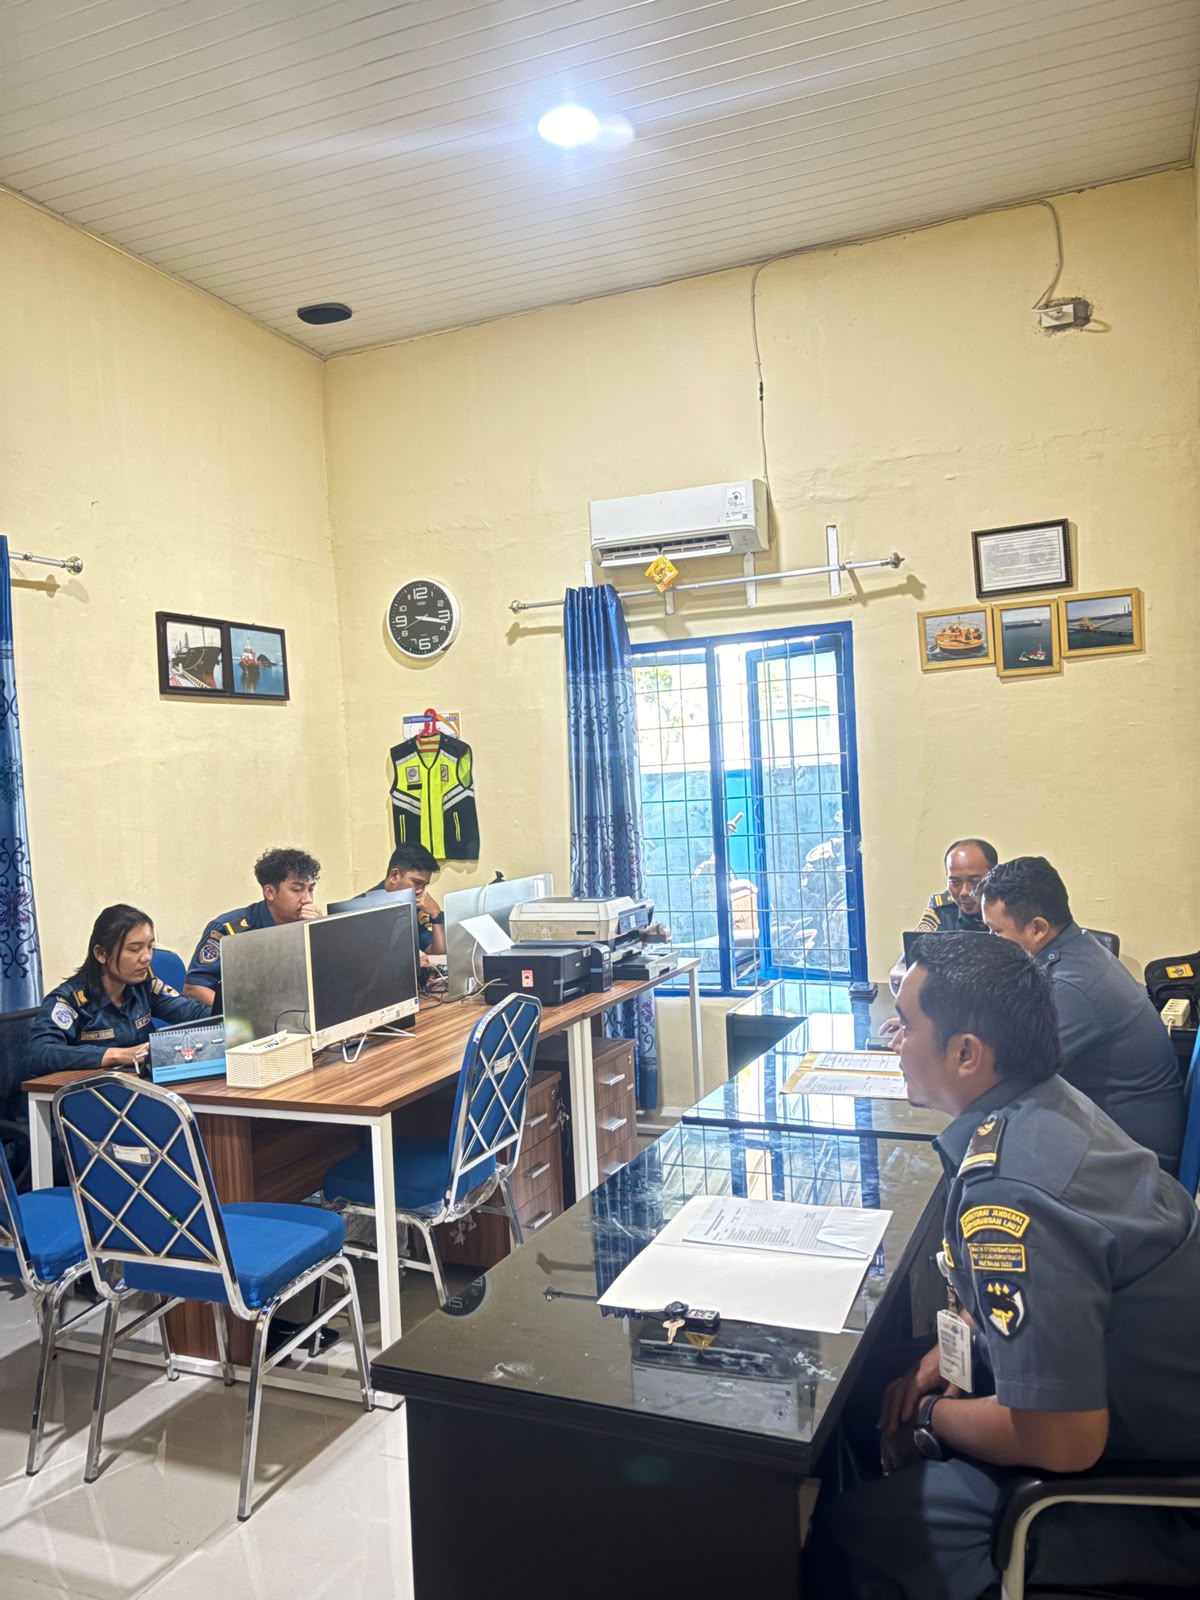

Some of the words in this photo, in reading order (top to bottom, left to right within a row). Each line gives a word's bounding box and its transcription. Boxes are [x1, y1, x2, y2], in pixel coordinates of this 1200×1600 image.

[413, 587, 428, 600] 12
[395, 615, 408, 628] 9
[437, 609, 451, 622] 3
[418, 637, 431, 650] 6
[431, 635, 439, 643] 5
[991, 1209, 1024, 1225] JENDERAL
[1003, 1220, 1021, 1232] LAUT
